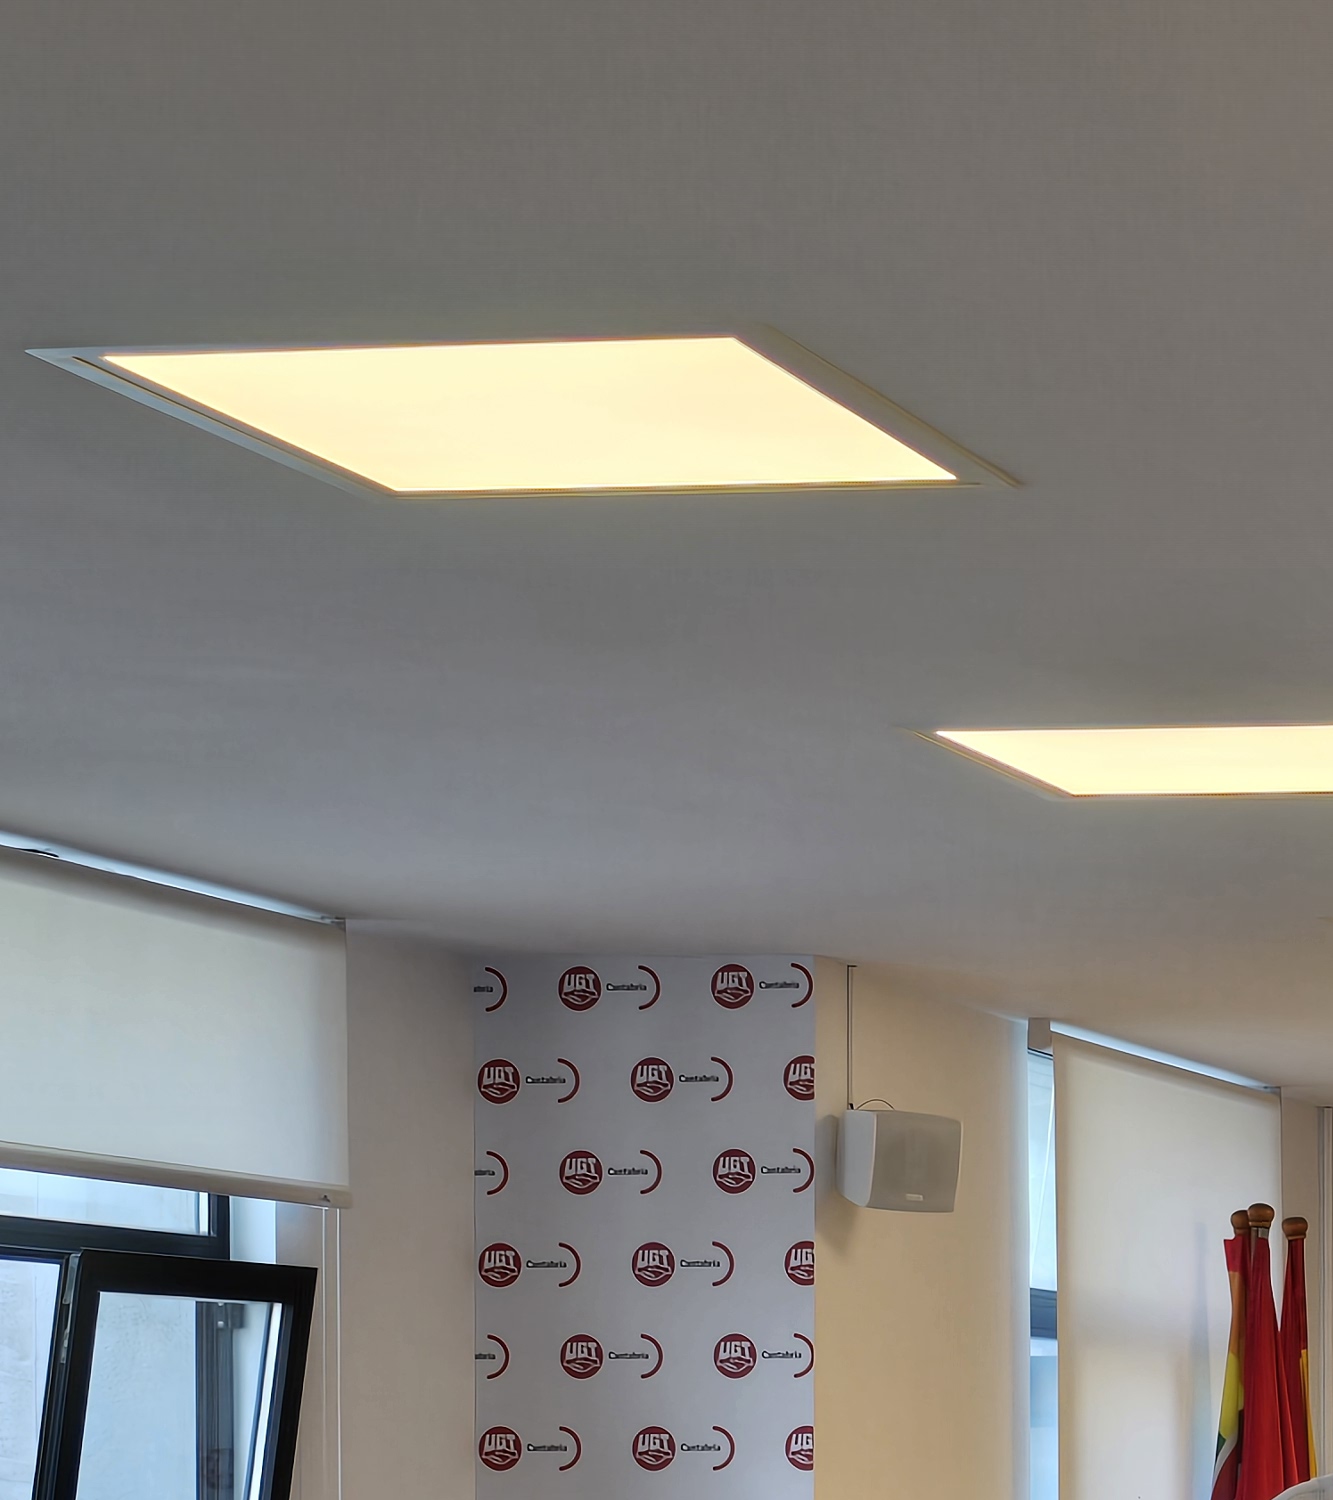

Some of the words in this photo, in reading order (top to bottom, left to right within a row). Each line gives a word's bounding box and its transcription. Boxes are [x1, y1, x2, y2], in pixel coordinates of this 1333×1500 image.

[564, 974, 598, 990] UGT
[716, 972, 750, 989] UGT
[484, 1066, 518, 1084] UGT
[636, 1065, 670, 1082] UGT
[564, 1158, 598, 1174] UGT
[718, 1157, 752, 1174] UGT
[484, 1250, 518, 1267] UGT
[637, 1250, 671, 1266] UGT
[566, 1342, 600, 1359] UGT
[718, 1342, 752, 1358] UGT
[484, 1434, 518, 1450] UGT
[637, 1434, 671, 1450] UGT
